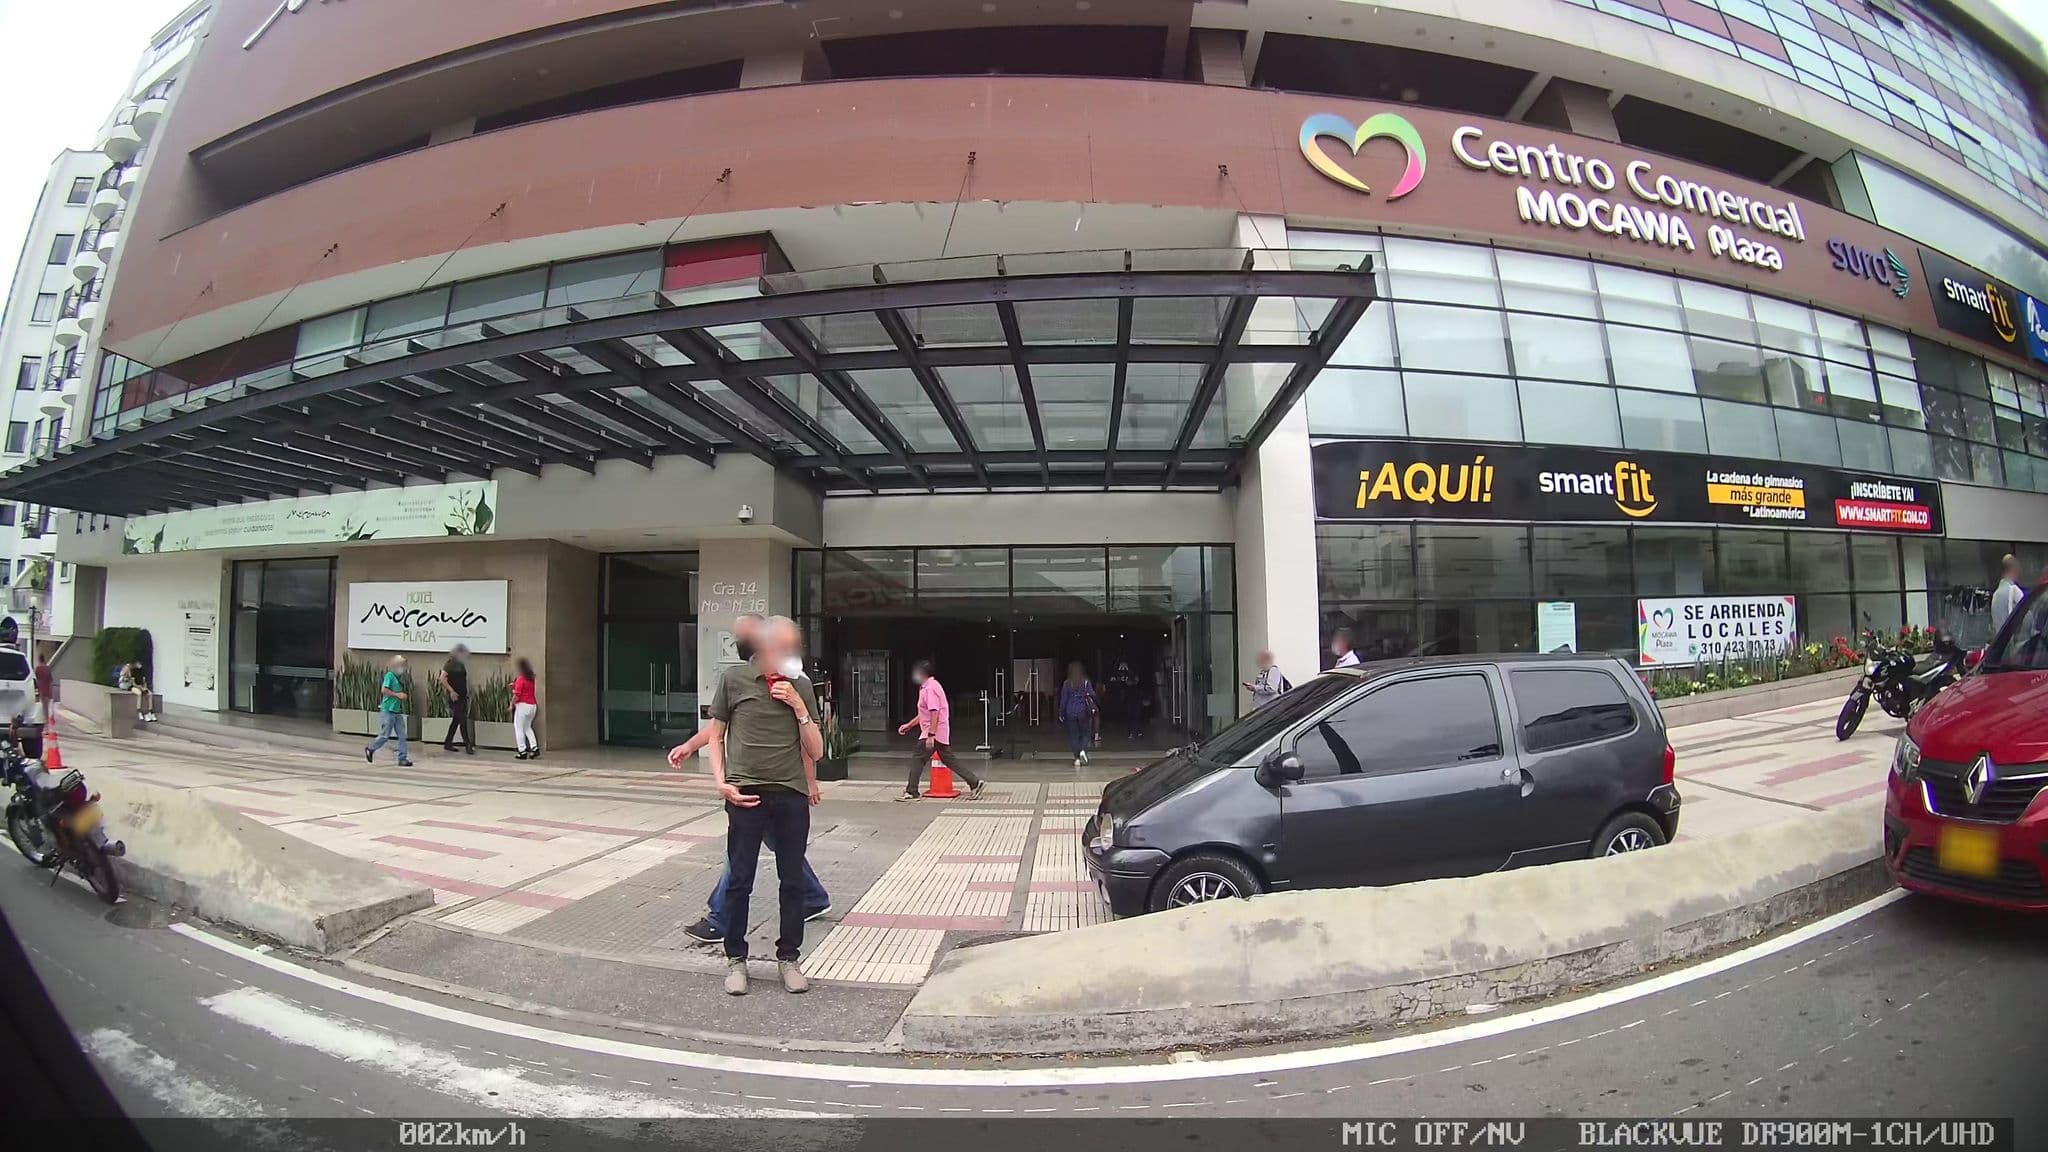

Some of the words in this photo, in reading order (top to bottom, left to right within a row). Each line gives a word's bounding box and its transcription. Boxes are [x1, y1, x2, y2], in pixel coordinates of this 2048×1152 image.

[1451, 127, 1616, 192] Centro
[1626, 160, 1805, 241] Comercial
[1515, 185, 1696, 251] MOCAWA
[1707, 224, 1784, 272] Plaza
[1826, 239, 1891, 288] sura
[1356, 456, 1495, 509] ¡AQUÍ!
[1706, 470, 1718, 483] La
[1720, 472, 1750, 485] cadena
[1752, 473, 1763, 486] de
[1764, 474, 1804, 489] gimnasios
[1730, 487, 1752, 501] más
[1755, 489, 1791, 504] grande
[1750, 505, 1806, 520] Latinoamérica
[1838, 505, 1928, 525] WWW.SMARTFIT.COM.CO
[740, 581, 758, 595] 14
[406, 591, 434, 604] HOTEL
[361, 603, 487, 628] Mocawa
[1684, 605, 1705, 620] SE
[1710, 603, 1785, 619] ARRIENDA
[403, 630, 436, 643] PLAZA
[1688, 621, 1783, 639] LOCALES
[1701, 642, 1721, 654] 310
[1725, 640, 1744, 653] 423
